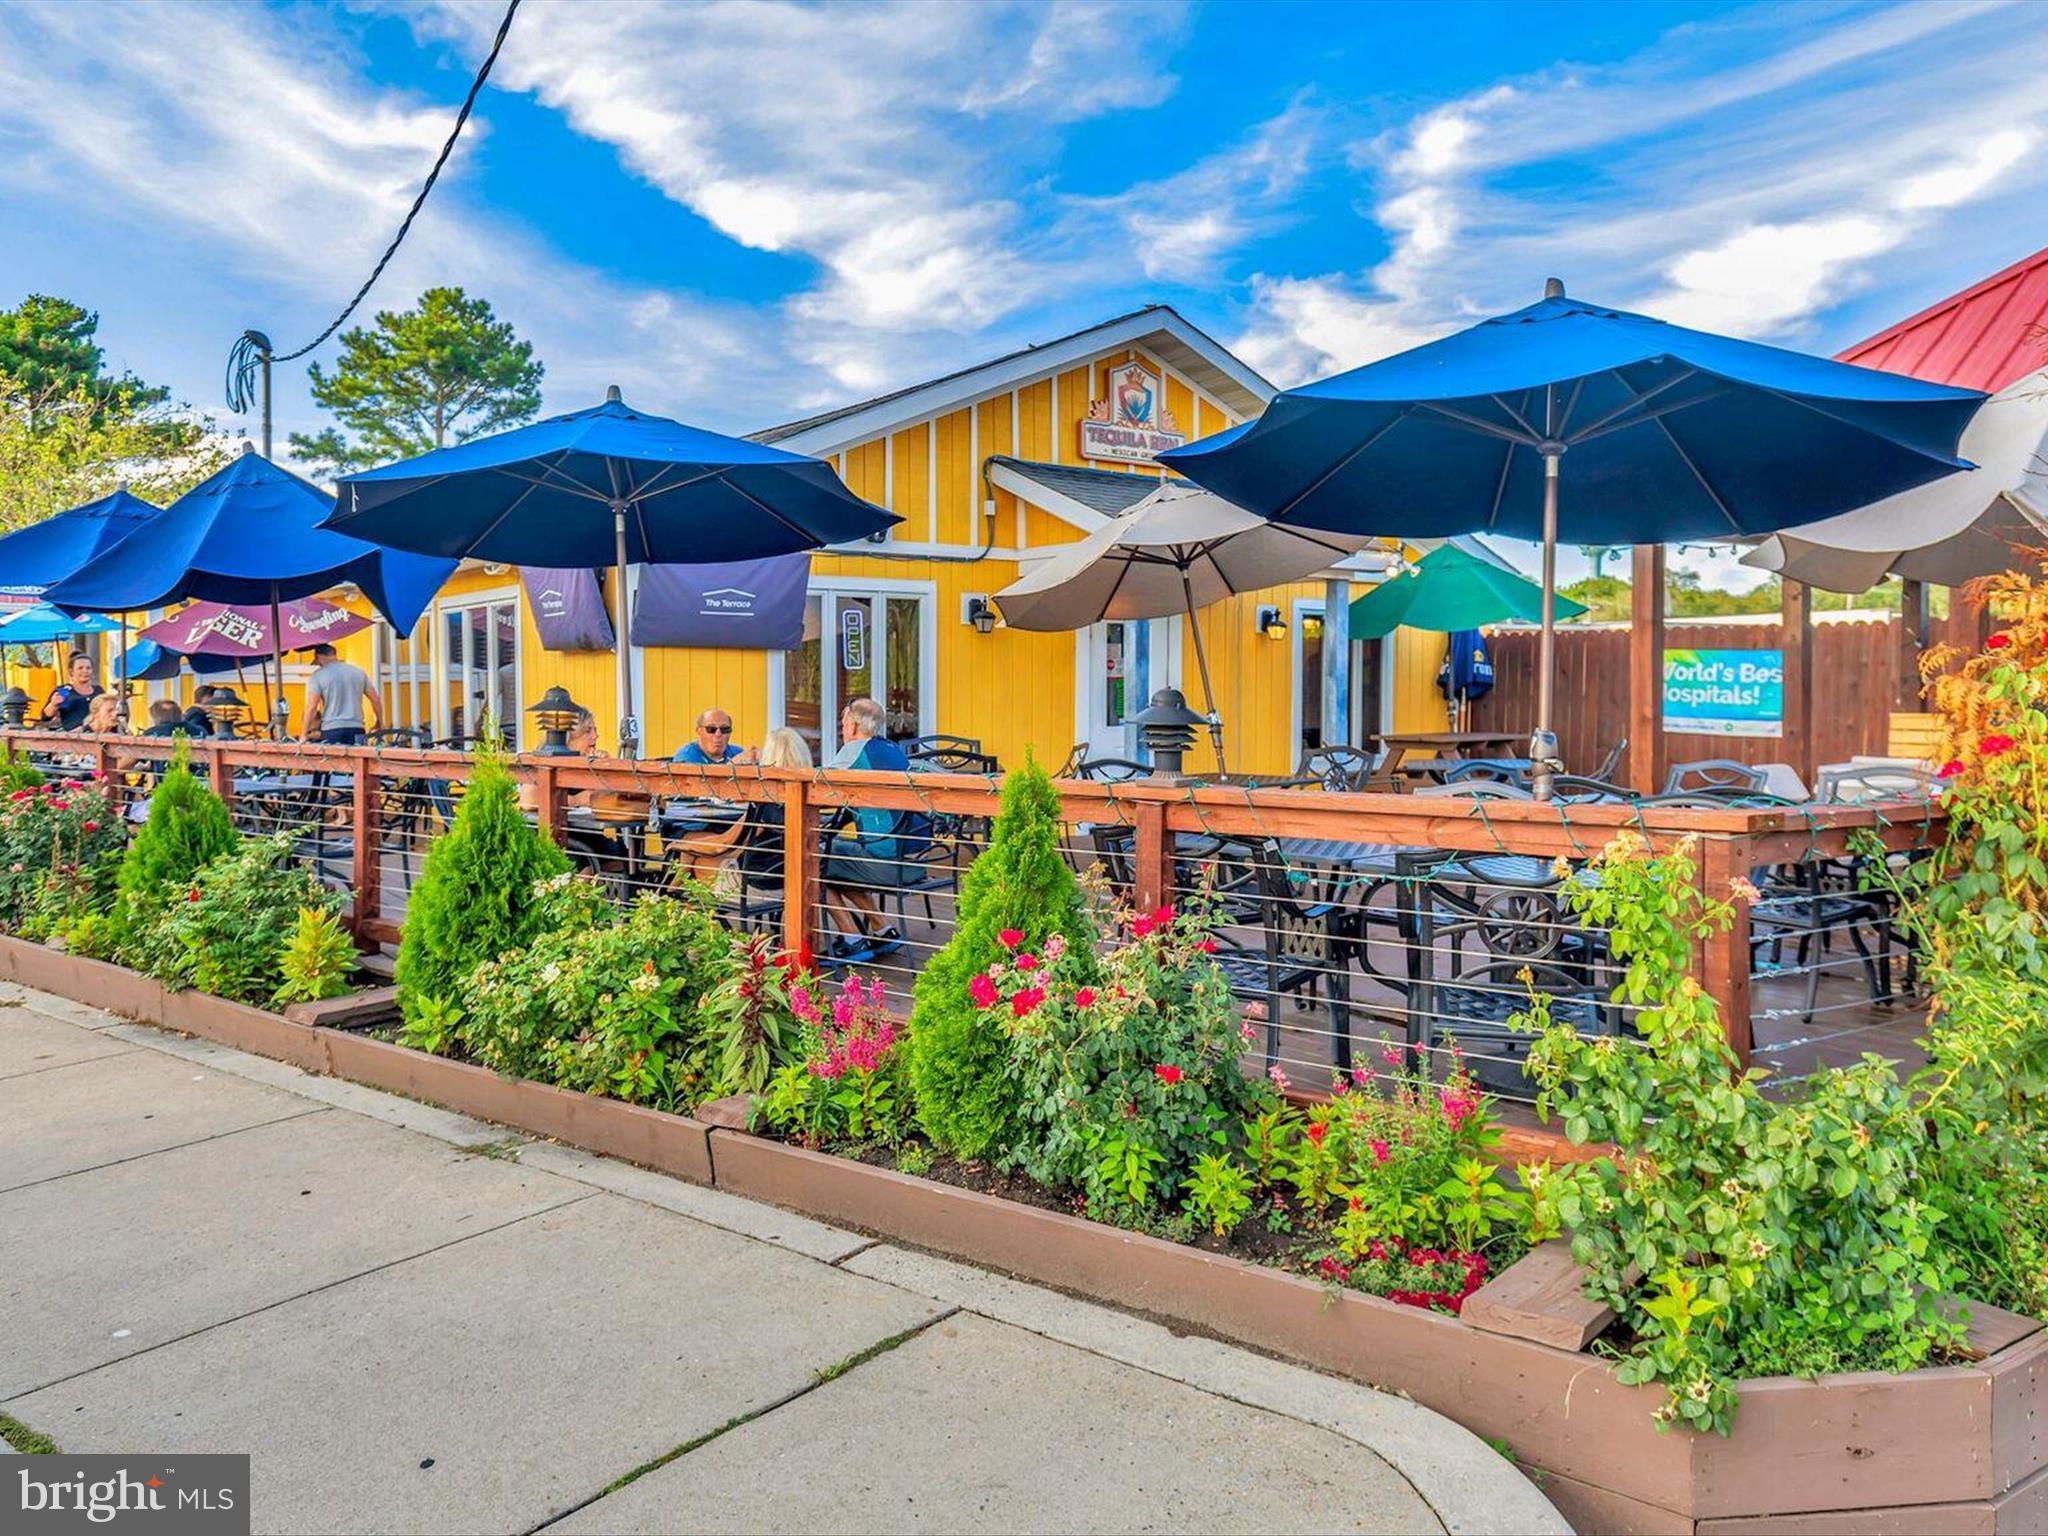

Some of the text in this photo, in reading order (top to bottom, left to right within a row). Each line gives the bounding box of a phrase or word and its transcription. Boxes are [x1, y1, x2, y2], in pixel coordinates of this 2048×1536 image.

[1087, 427, 1147, 449] TEQUILA
[705, 599, 752, 608] The Terrace
[846, 613, 861, 666] OPEN
[1739, 662, 1783, 683] Bes
